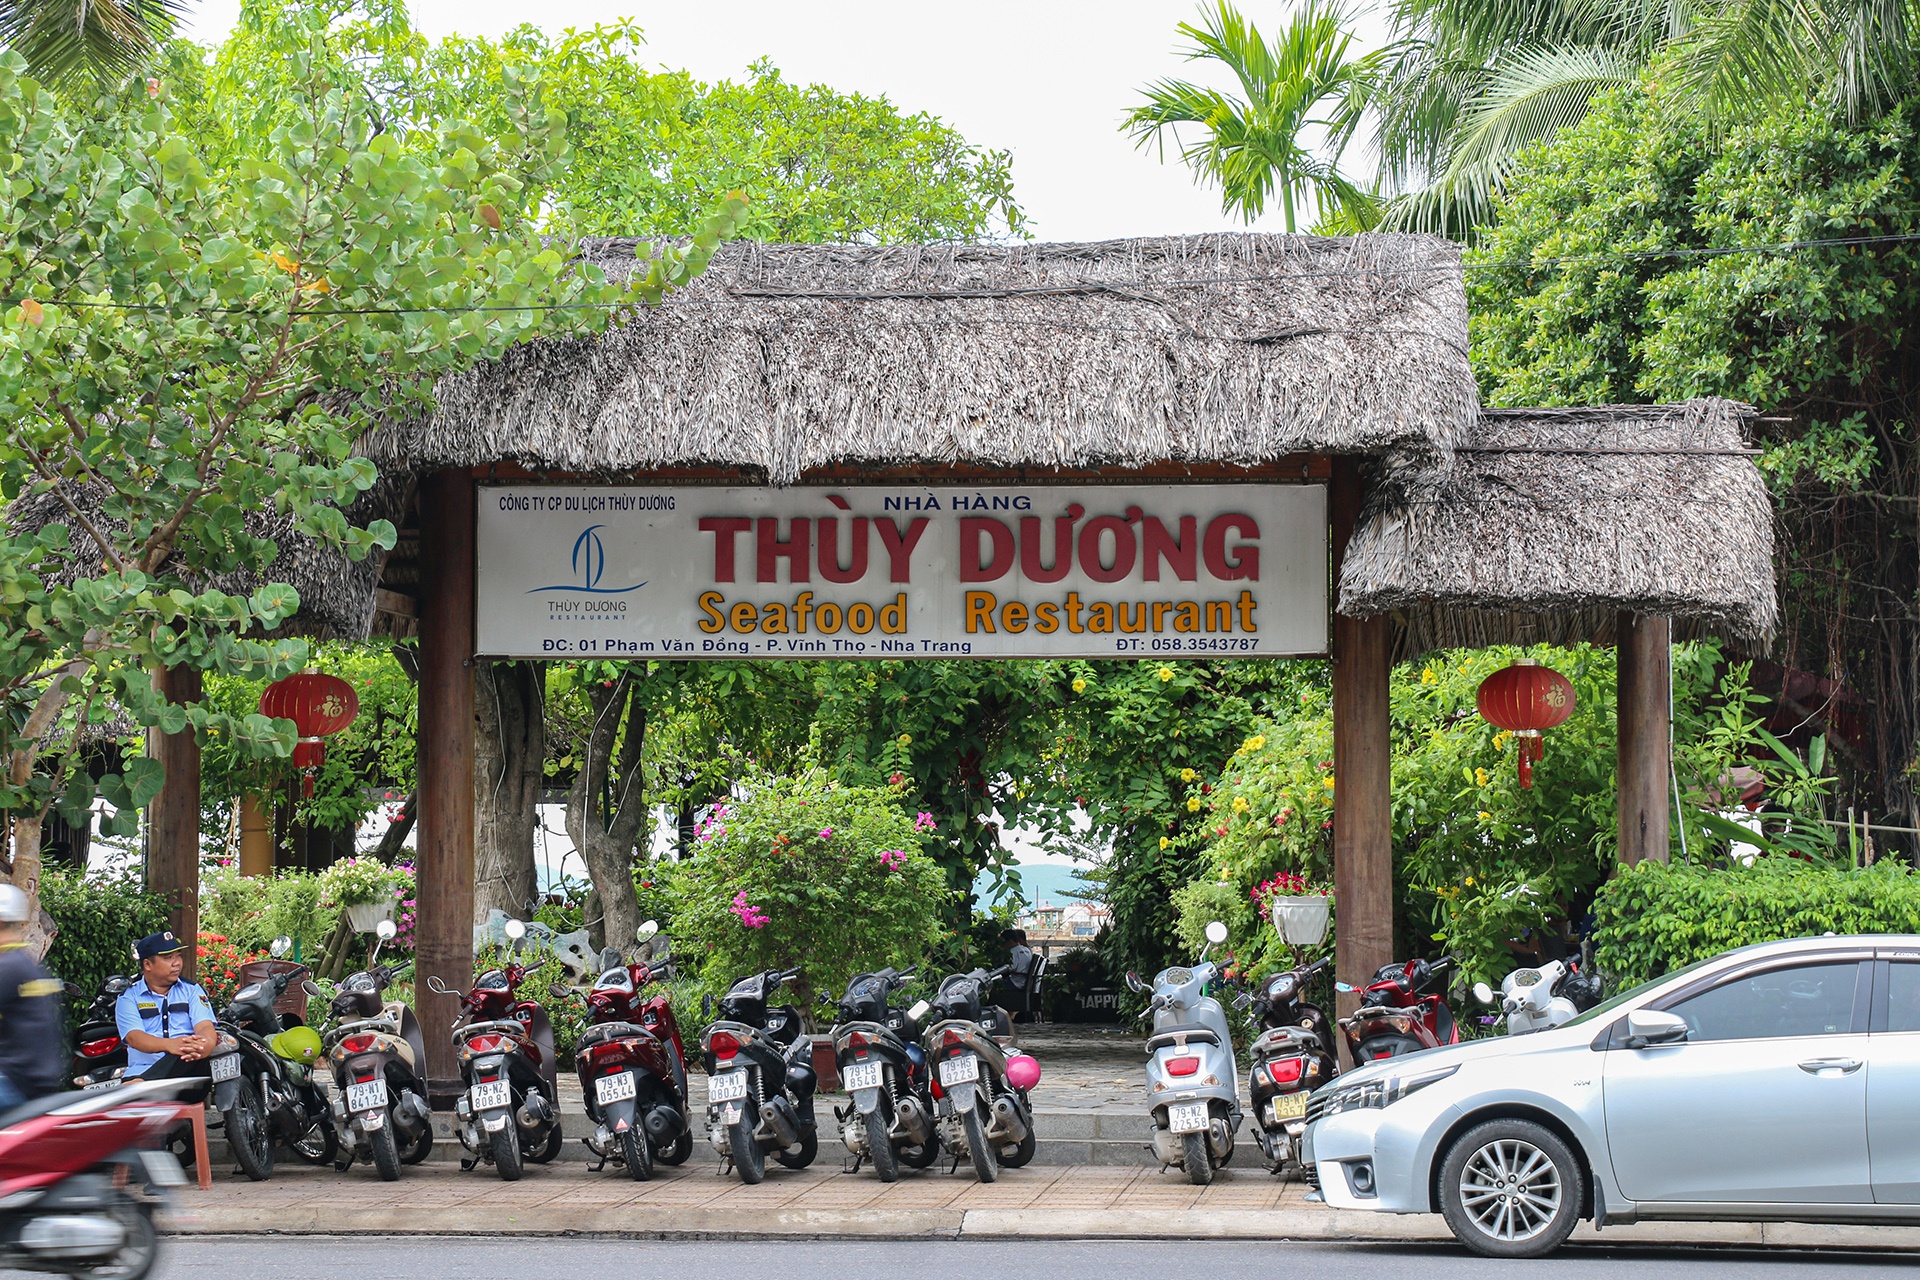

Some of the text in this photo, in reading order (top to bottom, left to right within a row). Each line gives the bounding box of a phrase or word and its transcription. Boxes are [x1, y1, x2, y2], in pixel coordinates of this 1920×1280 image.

[499, 493, 676, 514] CÔNG TY CP DU LỊCH THÙY DƯƠNG
[884, 493, 1031, 510] NHÀ HÀNG
[698, 495, 1261, 584] THÙY DƯƠNG
[548, 599, 627, 612] THÙY DƯƠNG
[697, 590, 1258, 634] Seafood Restaurant
[542, 639, 573, 651] ĐC:
[579, 639, 597, 651] 01
[605, 639, 655, 654] Phạm
[661, 638, 695, 651] Văn
[702, 637, 749, 654] Đồng
[767, 639, 782, 651] P.
[787, 638, 826, 651] Vĩnh
[832, 639, 866, 654] Thọ
[881, 639, 915, 651] Nha
[921, 639, 972, 654] Trang
[1116, 638, 1260, 651] ĐT: 058.3543787
[1546, 684, 1566, 708] 福
[321, 694, 344, 718] 福
[210, 1057, 233, 1070] 9-Z1
[850, 1064, 876, 1077] 79-L5
[945, 1058, 971, 1072] 79-H5
[602, 1074, 628, 1090] 79-N3
[714, 1074, 739, 1088] 79-N1
[850, 1075, 877, 1088] 8548
[946, 1068, 973, 1082] 9225
[353, 1082, 379, 1098] 79-N1
[477, 1083, 504, 1096] 79-N2
[600, 1085, 633, 1102] 055.44
[710, 1085, 744, 1100] 080.27
[351, 1093, 385, 1109] 841.24
[475, 1093, 508, 1108] 808.81
[1278, 1093, 1305, 1108] 79-N1
[1176, 1106, 1202, 1119] 79-N2
